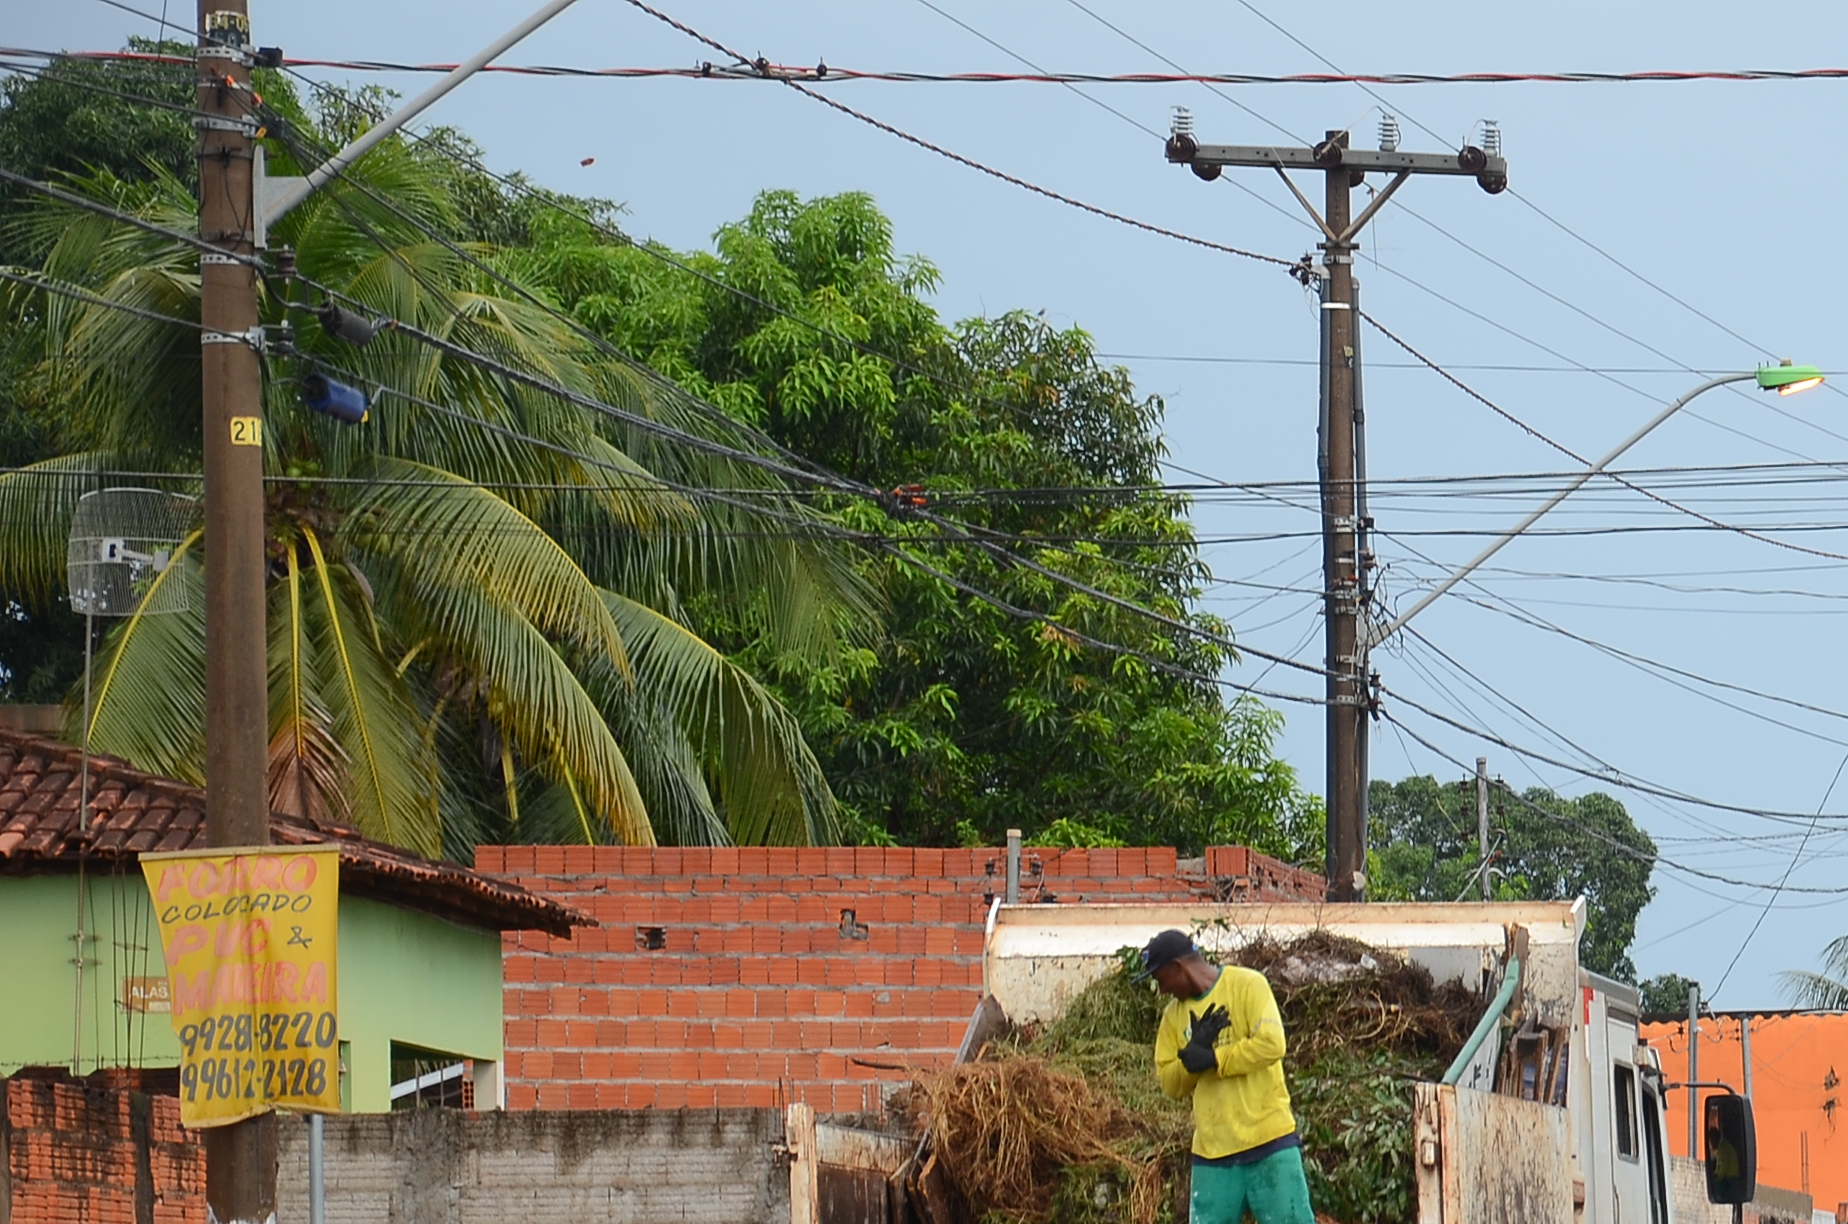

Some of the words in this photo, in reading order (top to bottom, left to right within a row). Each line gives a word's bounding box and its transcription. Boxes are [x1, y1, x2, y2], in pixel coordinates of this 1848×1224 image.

[233, 420, 260, 442] 21
[157, 855, 318, 902] FORRO
[131, 986, 168, 999] ALAS
